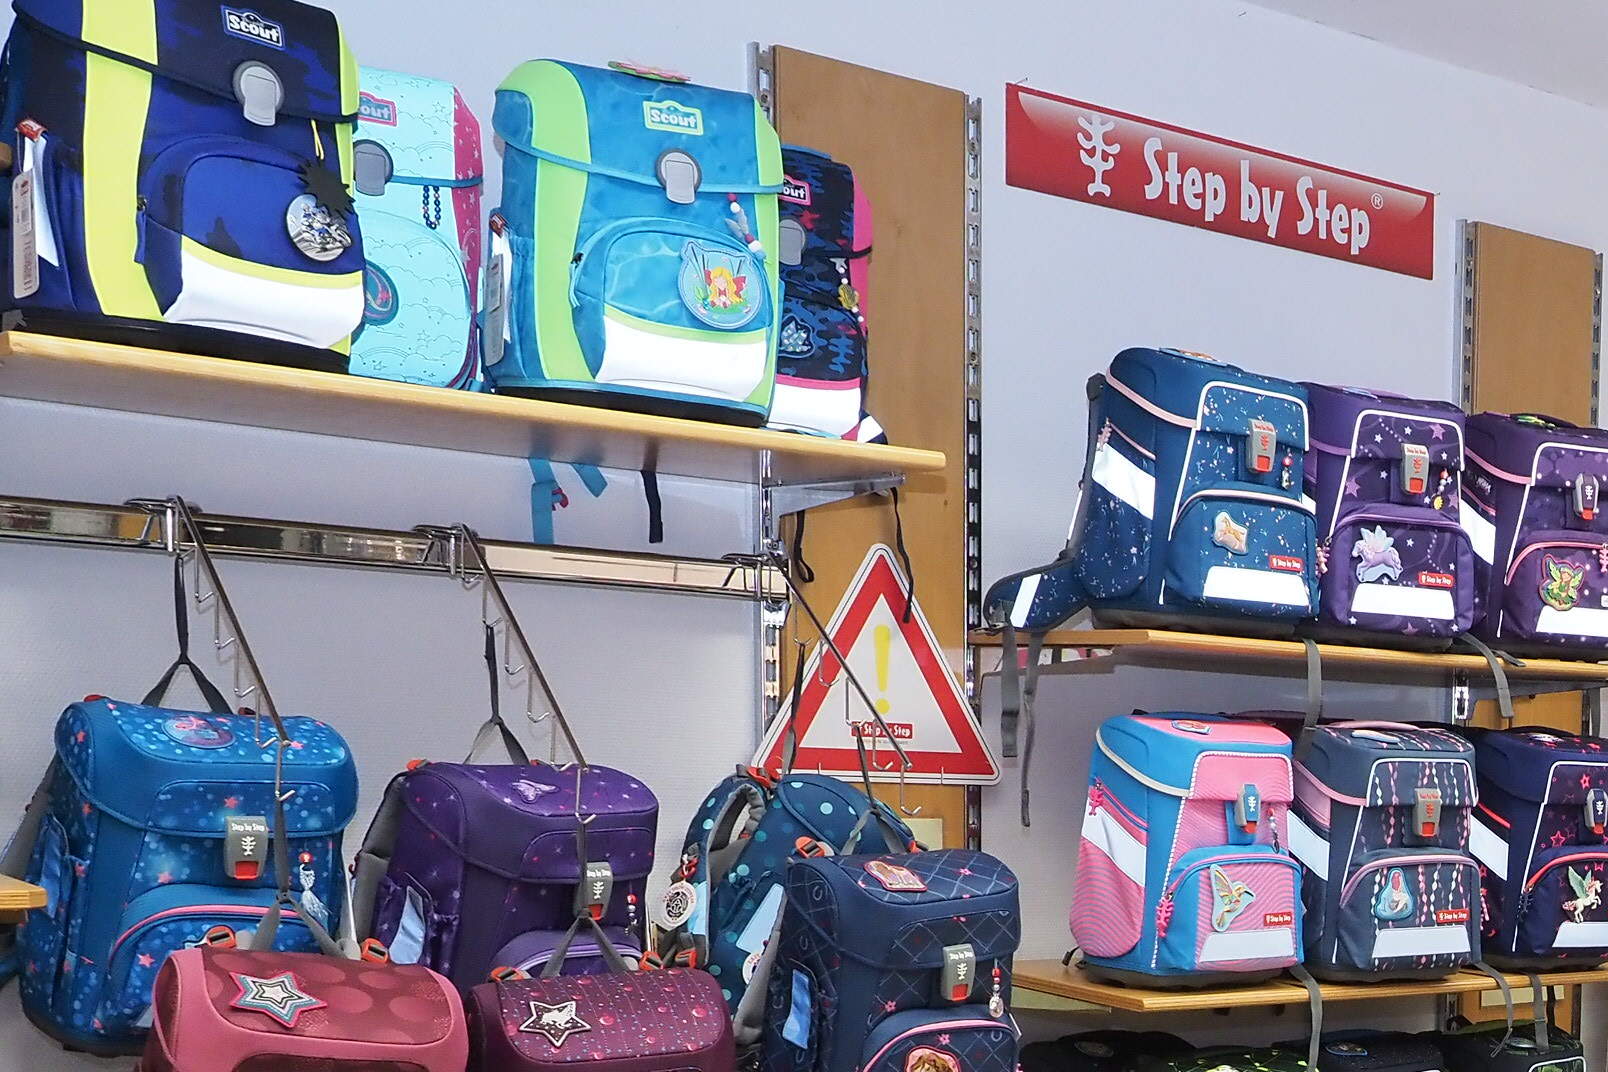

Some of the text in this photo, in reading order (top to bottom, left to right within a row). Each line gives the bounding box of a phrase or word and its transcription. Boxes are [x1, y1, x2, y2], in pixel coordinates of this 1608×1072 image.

[229, 14, 282, 43] Scout
[360, 103, 390, 120] out
[650, 110, 698, 129] Scout
[783, 184, 806, 200] out
[1143, 136, 1371, 256] Step by Step
[864, 724, 881, 737] Stp
